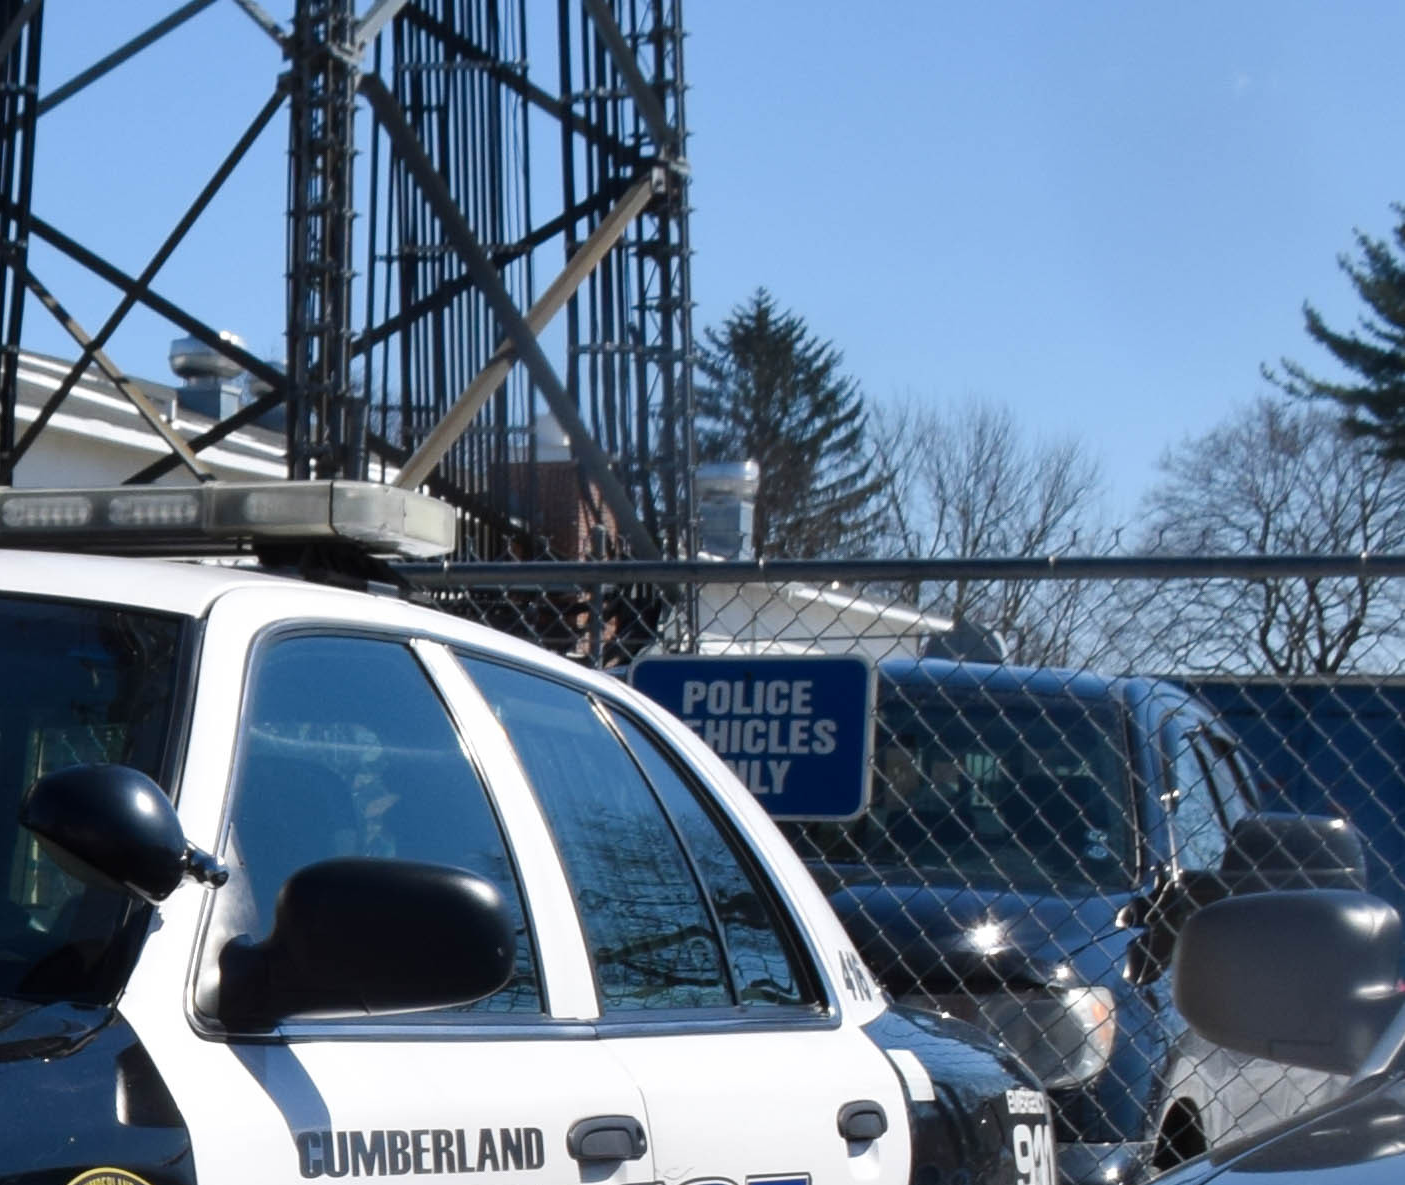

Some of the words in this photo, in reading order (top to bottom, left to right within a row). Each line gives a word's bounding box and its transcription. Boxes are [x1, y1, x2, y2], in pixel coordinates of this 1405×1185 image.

[682, 680, 813, 715] POLICE
[684, 719, 837, 754] HICLES
[728, 760, 791, 794] NLY
[297, 1126, 545, 1179] CUMBERLAND
